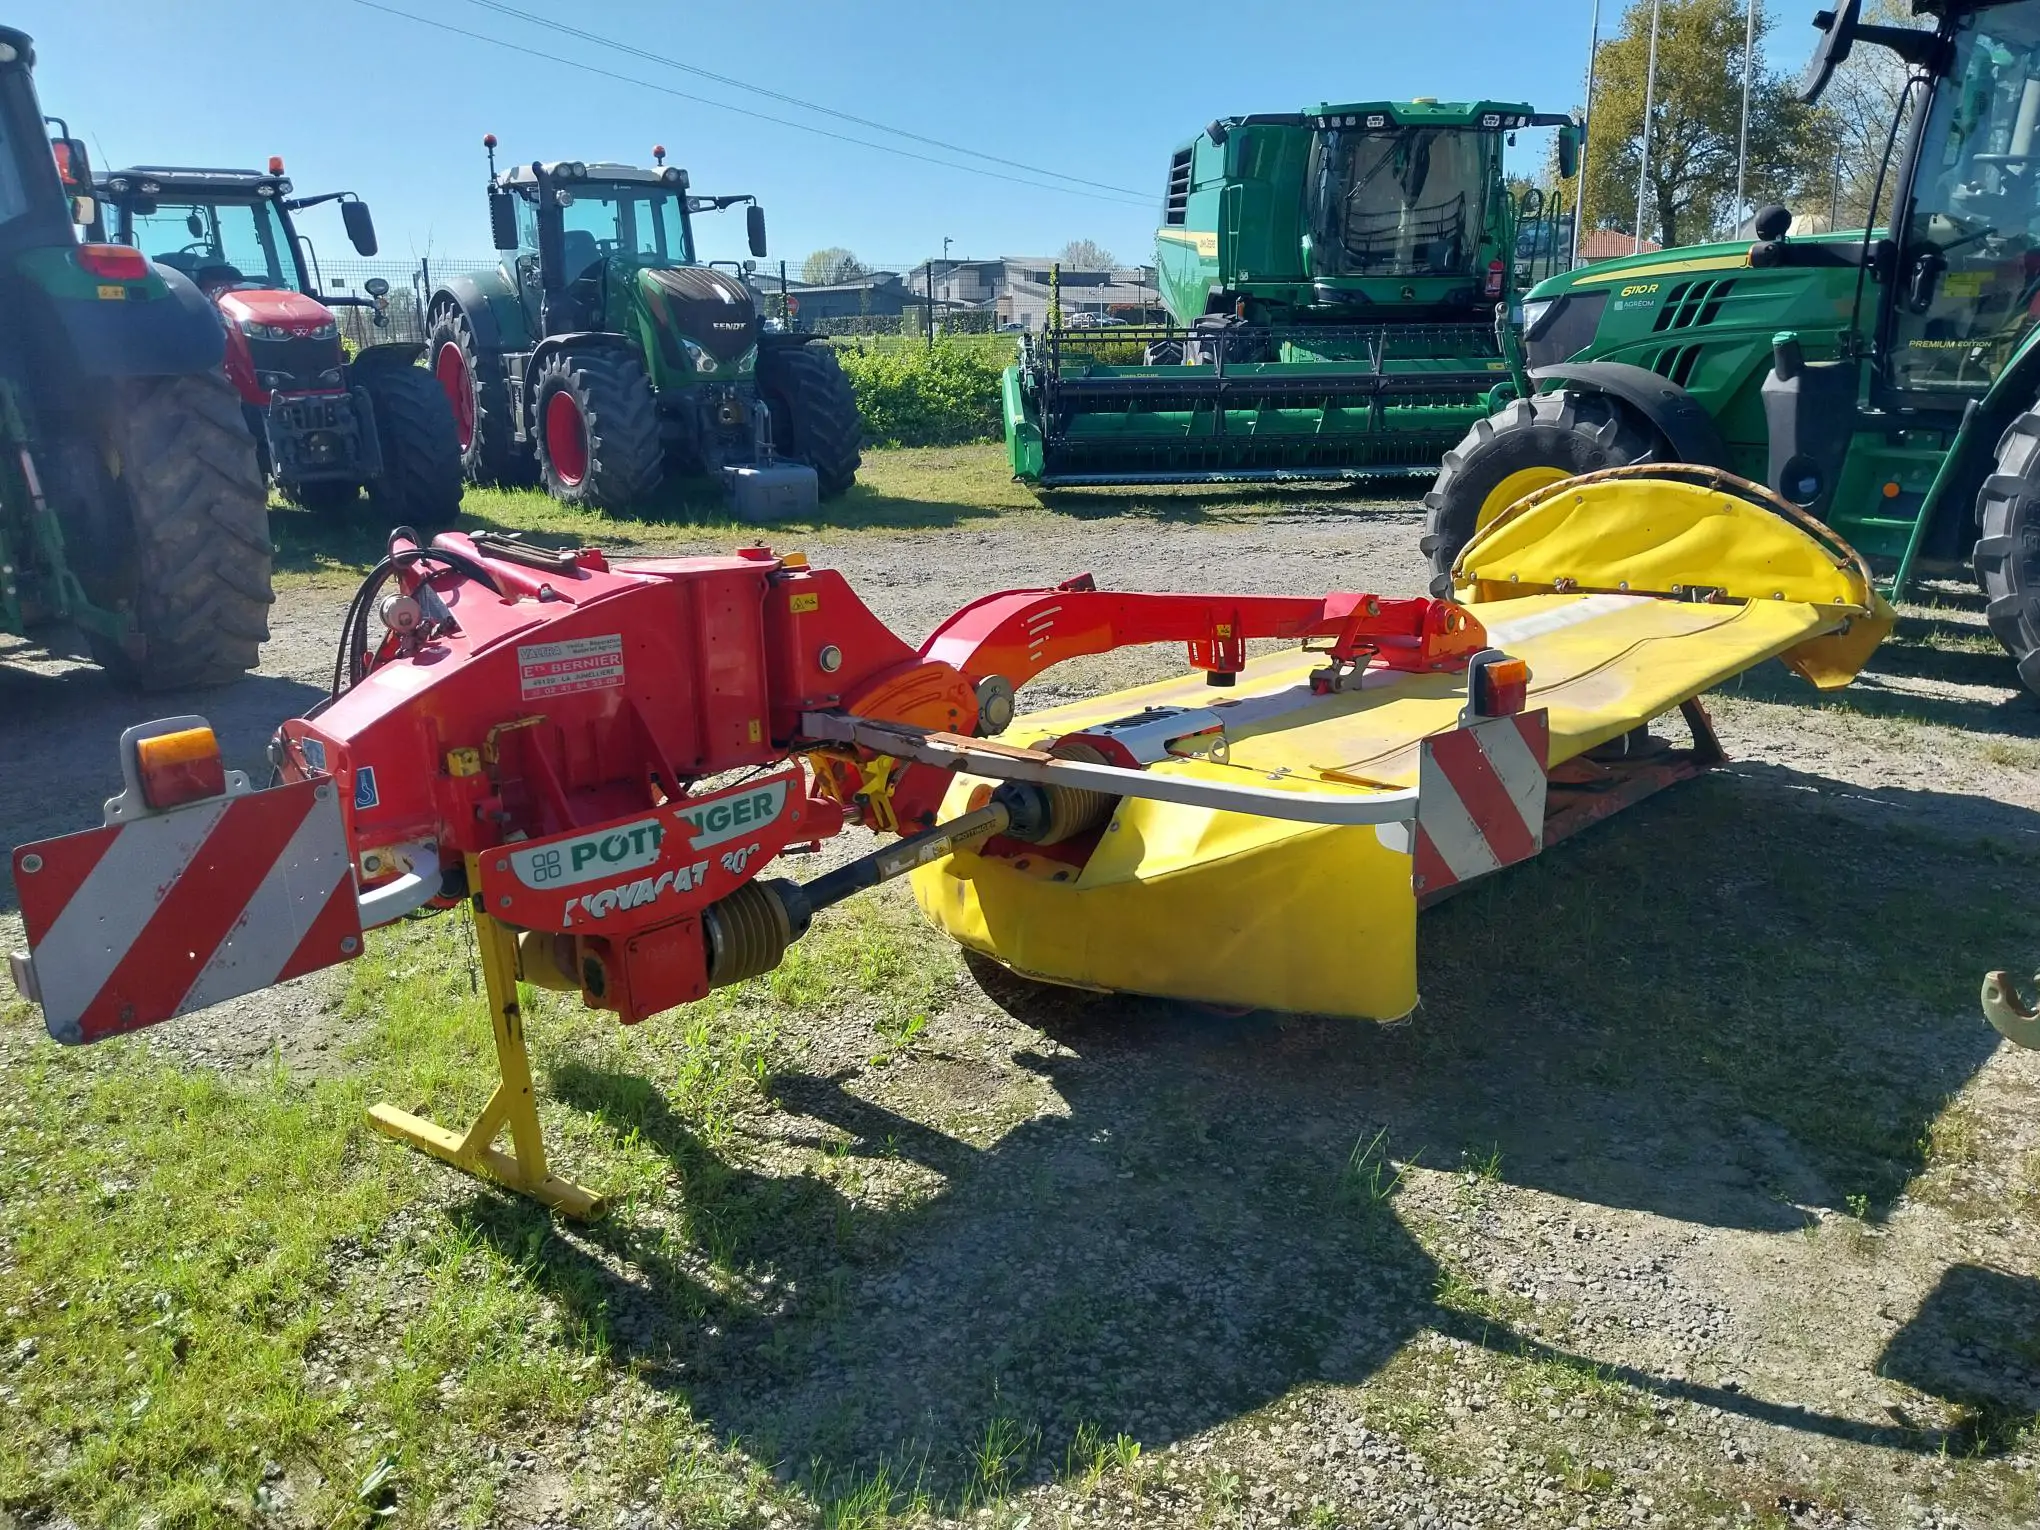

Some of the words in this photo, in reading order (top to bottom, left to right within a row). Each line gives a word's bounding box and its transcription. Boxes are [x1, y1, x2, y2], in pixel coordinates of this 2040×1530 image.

[1620, 285, 1647, 297] 6110
[1647, 283, 1659, 293] R
[713, 322, 747, 330] FENDT
[1908, 340, 1956, 348] PREMIUM
[551, 654, 621, 673] BERNIER
